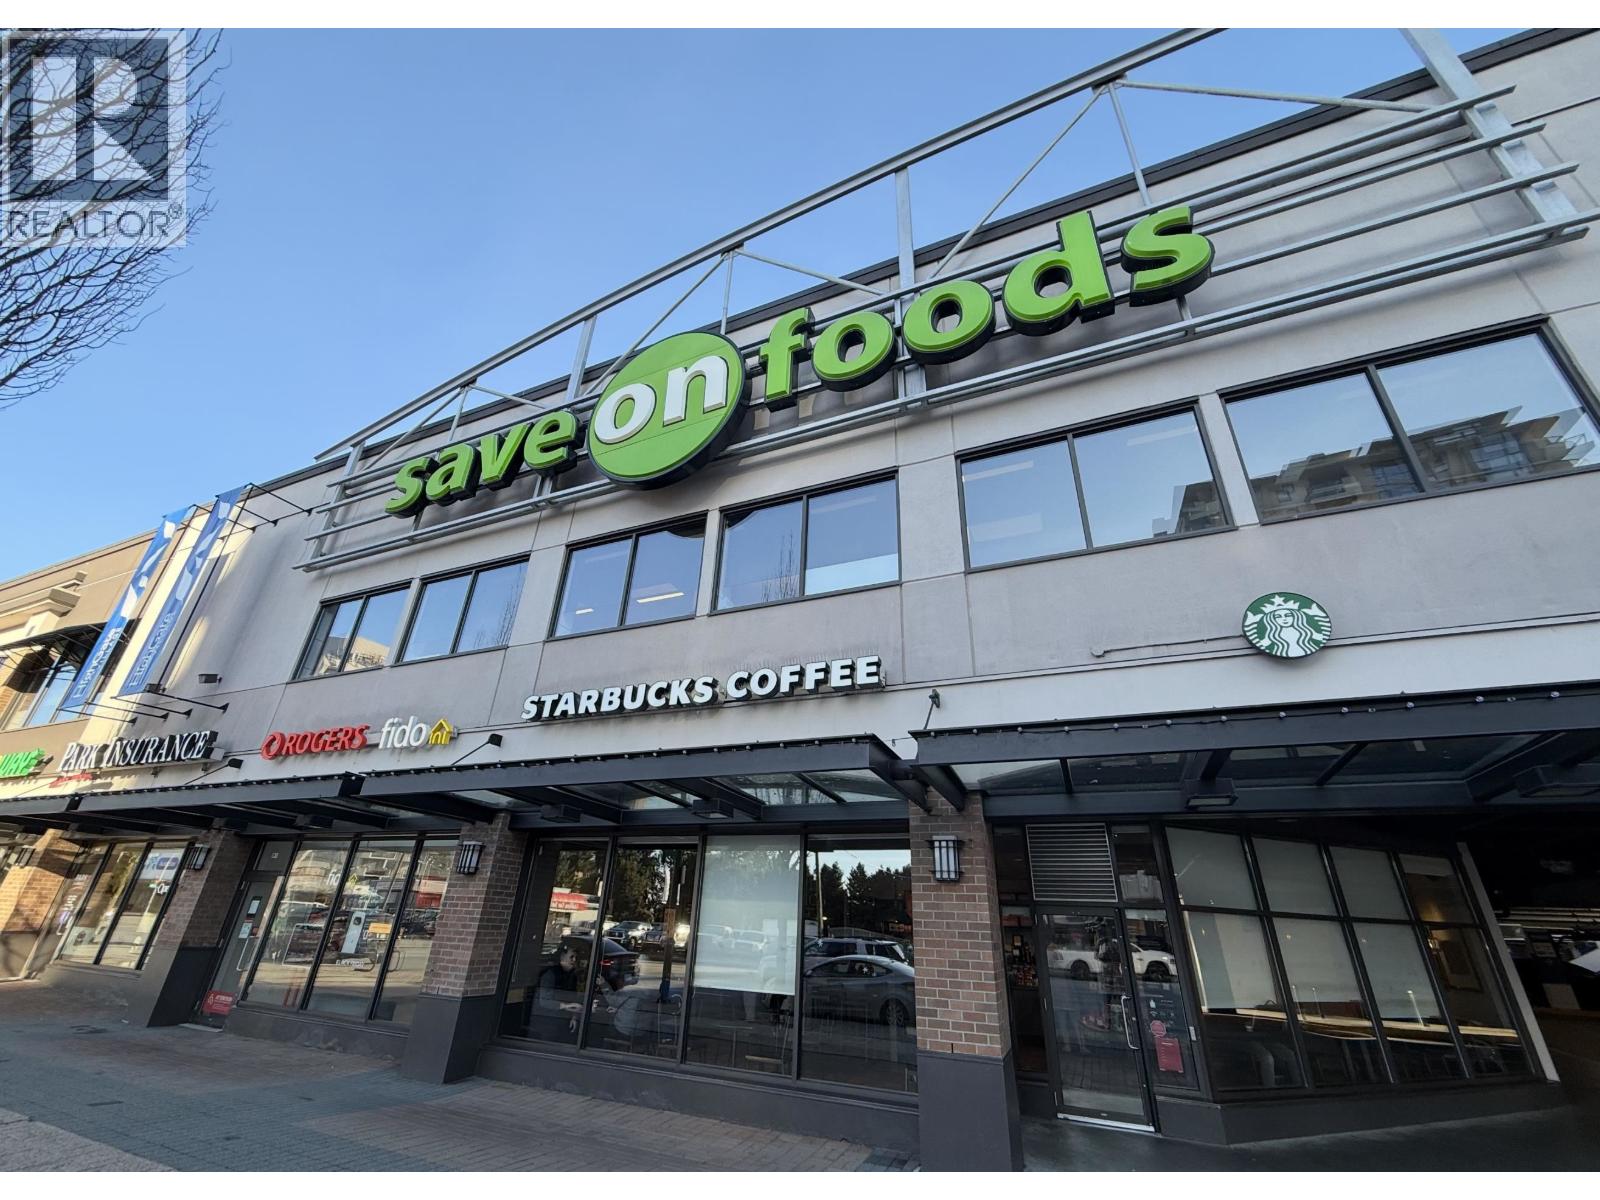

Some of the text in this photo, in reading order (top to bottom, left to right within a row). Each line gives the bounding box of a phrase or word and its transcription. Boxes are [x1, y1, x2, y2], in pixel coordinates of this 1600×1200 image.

[385, 205, 1214, 516] save on foods
[520, 655, 883, 721] STARBUCKS COFFEE
[56, 730, 210, 773] PARK INSURANCE
[281, 723, 369, 756] ROGERS
[378, 715, 428, 750] fido
